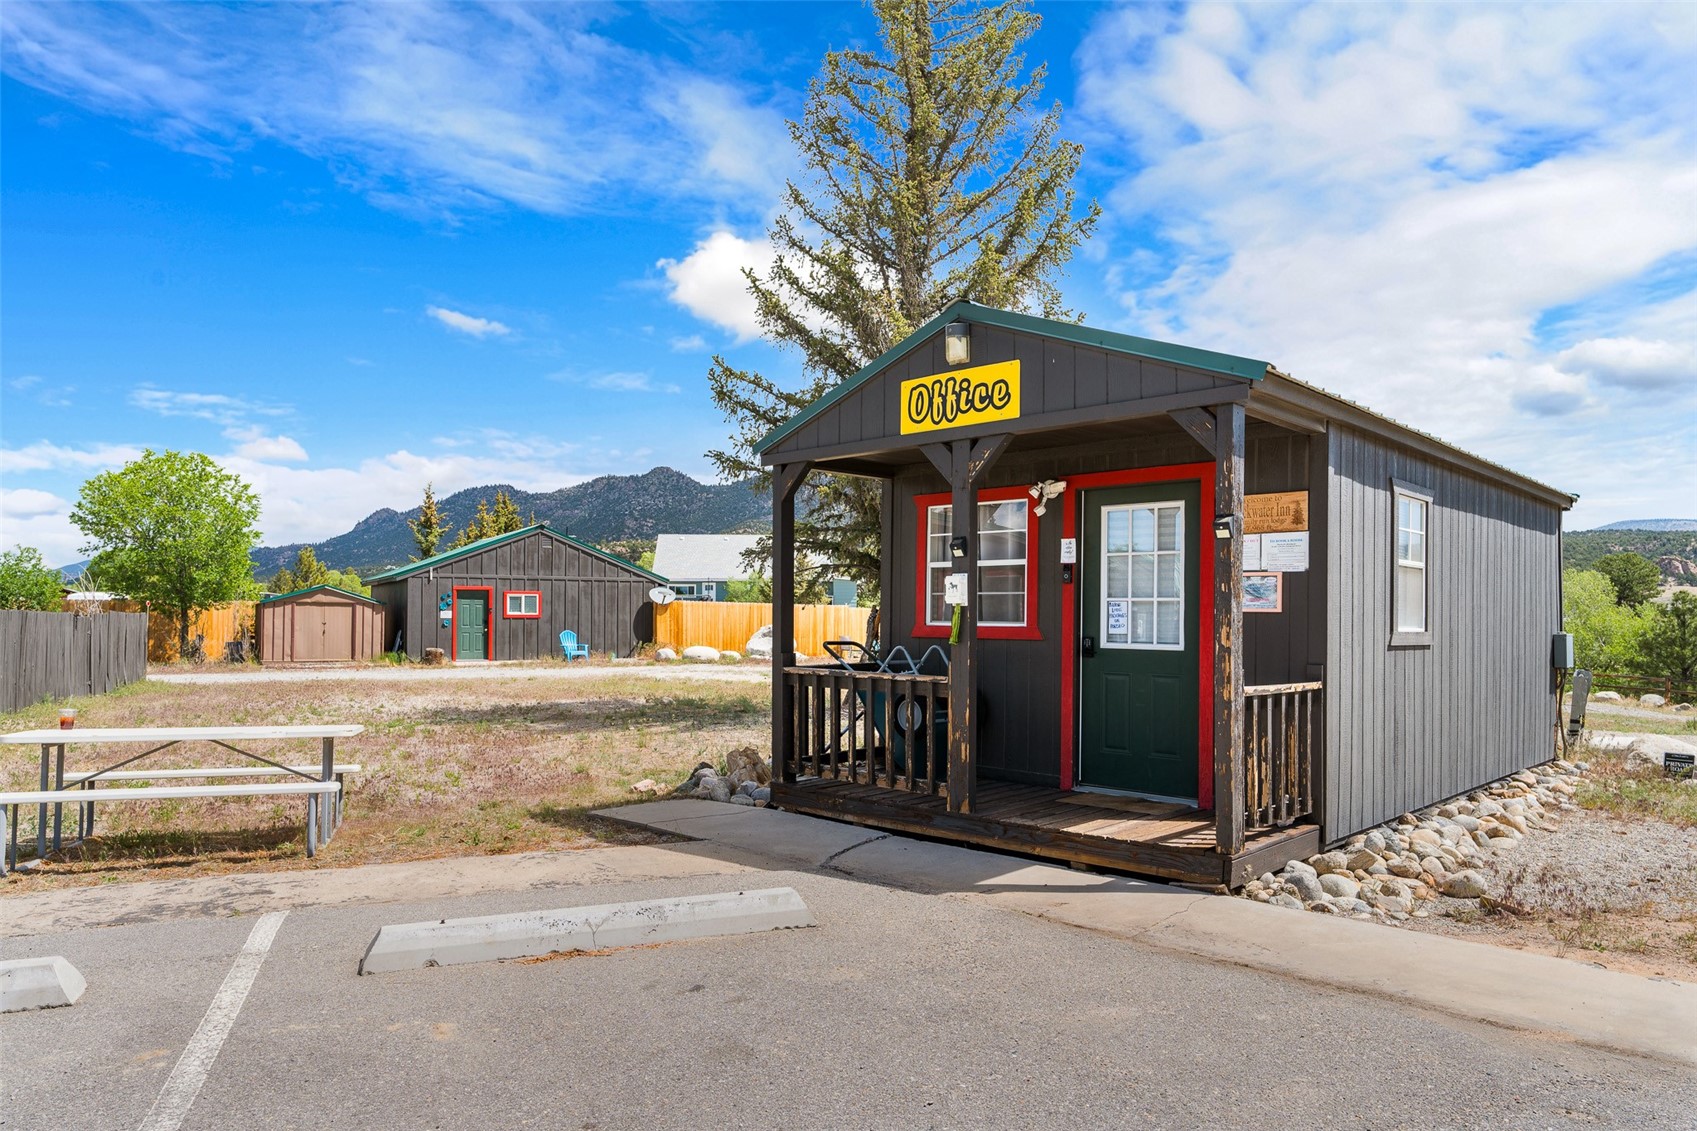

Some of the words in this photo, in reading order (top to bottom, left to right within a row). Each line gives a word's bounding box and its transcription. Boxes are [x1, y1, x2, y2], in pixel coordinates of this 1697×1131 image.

[908, 376, 1011, 425] Office
[1246, 495, 1273, 504] elcome
[1276, 502, 1291, 517] Inn
[1270, 517, 1287, 525] lodge
